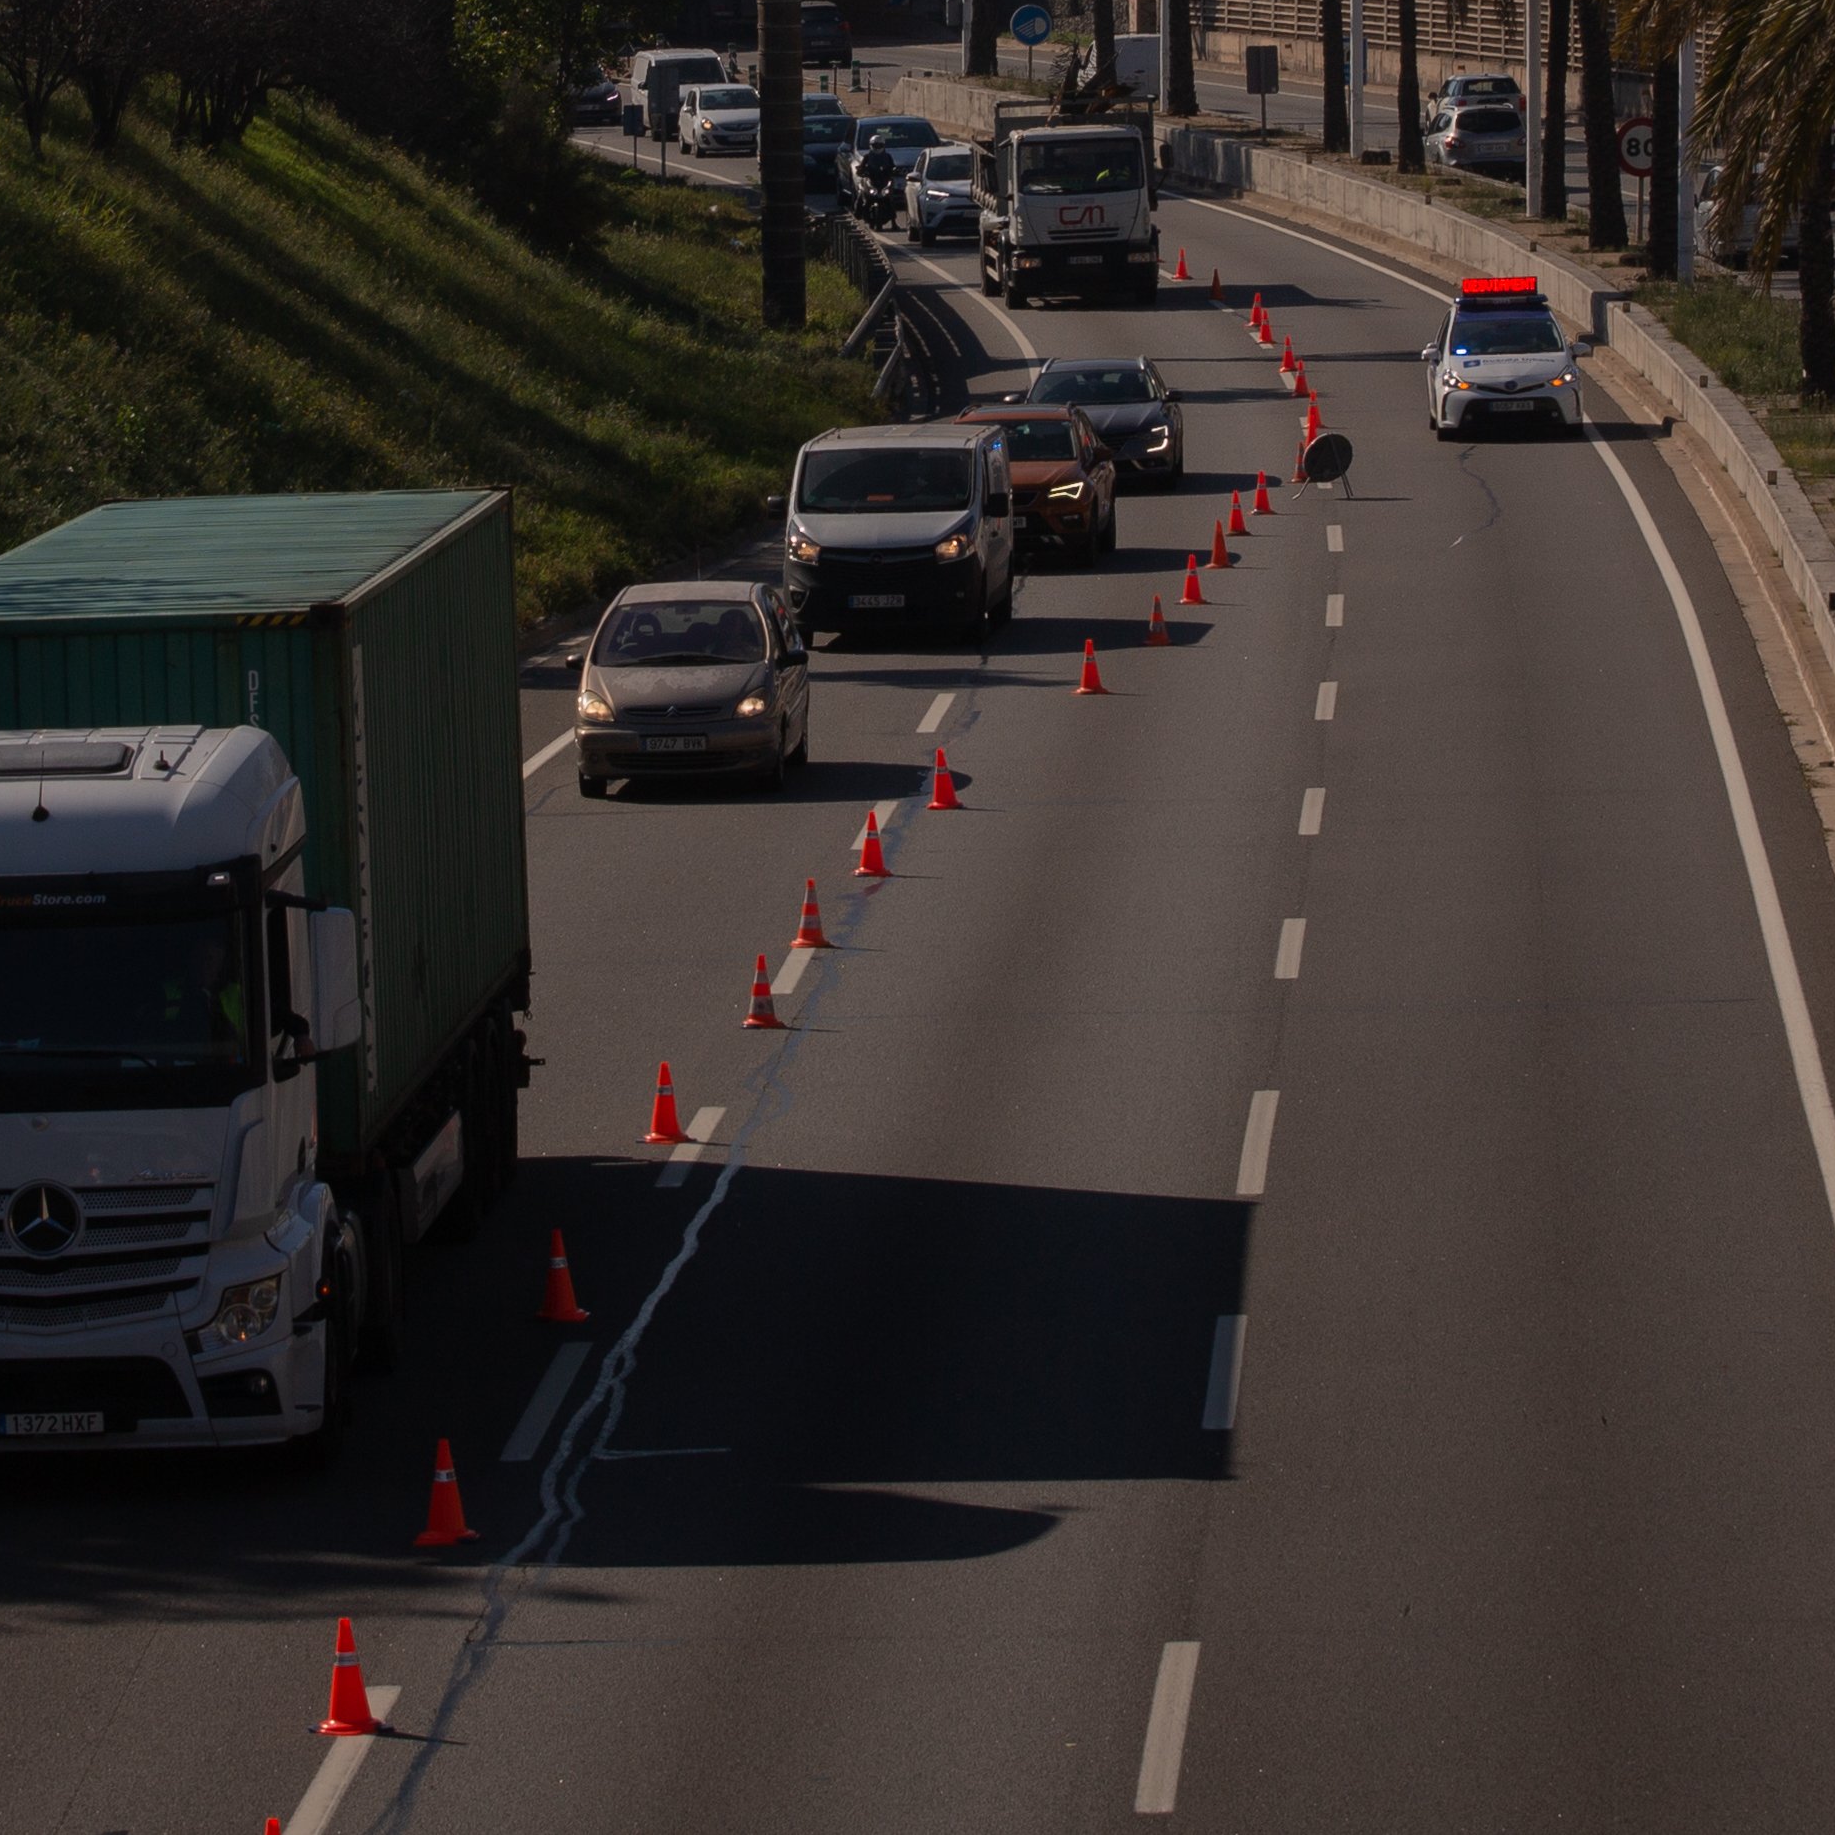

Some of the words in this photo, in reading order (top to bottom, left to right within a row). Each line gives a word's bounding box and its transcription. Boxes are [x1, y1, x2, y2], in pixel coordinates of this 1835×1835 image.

[1626, 137, 1653, 157] 80
[649, 738, 678, 750] 9747
[683, 738, 703, 749] BVK
[12, 1415, 58, 1433] 1372
[62, 1414, 97, 1432] HXF
